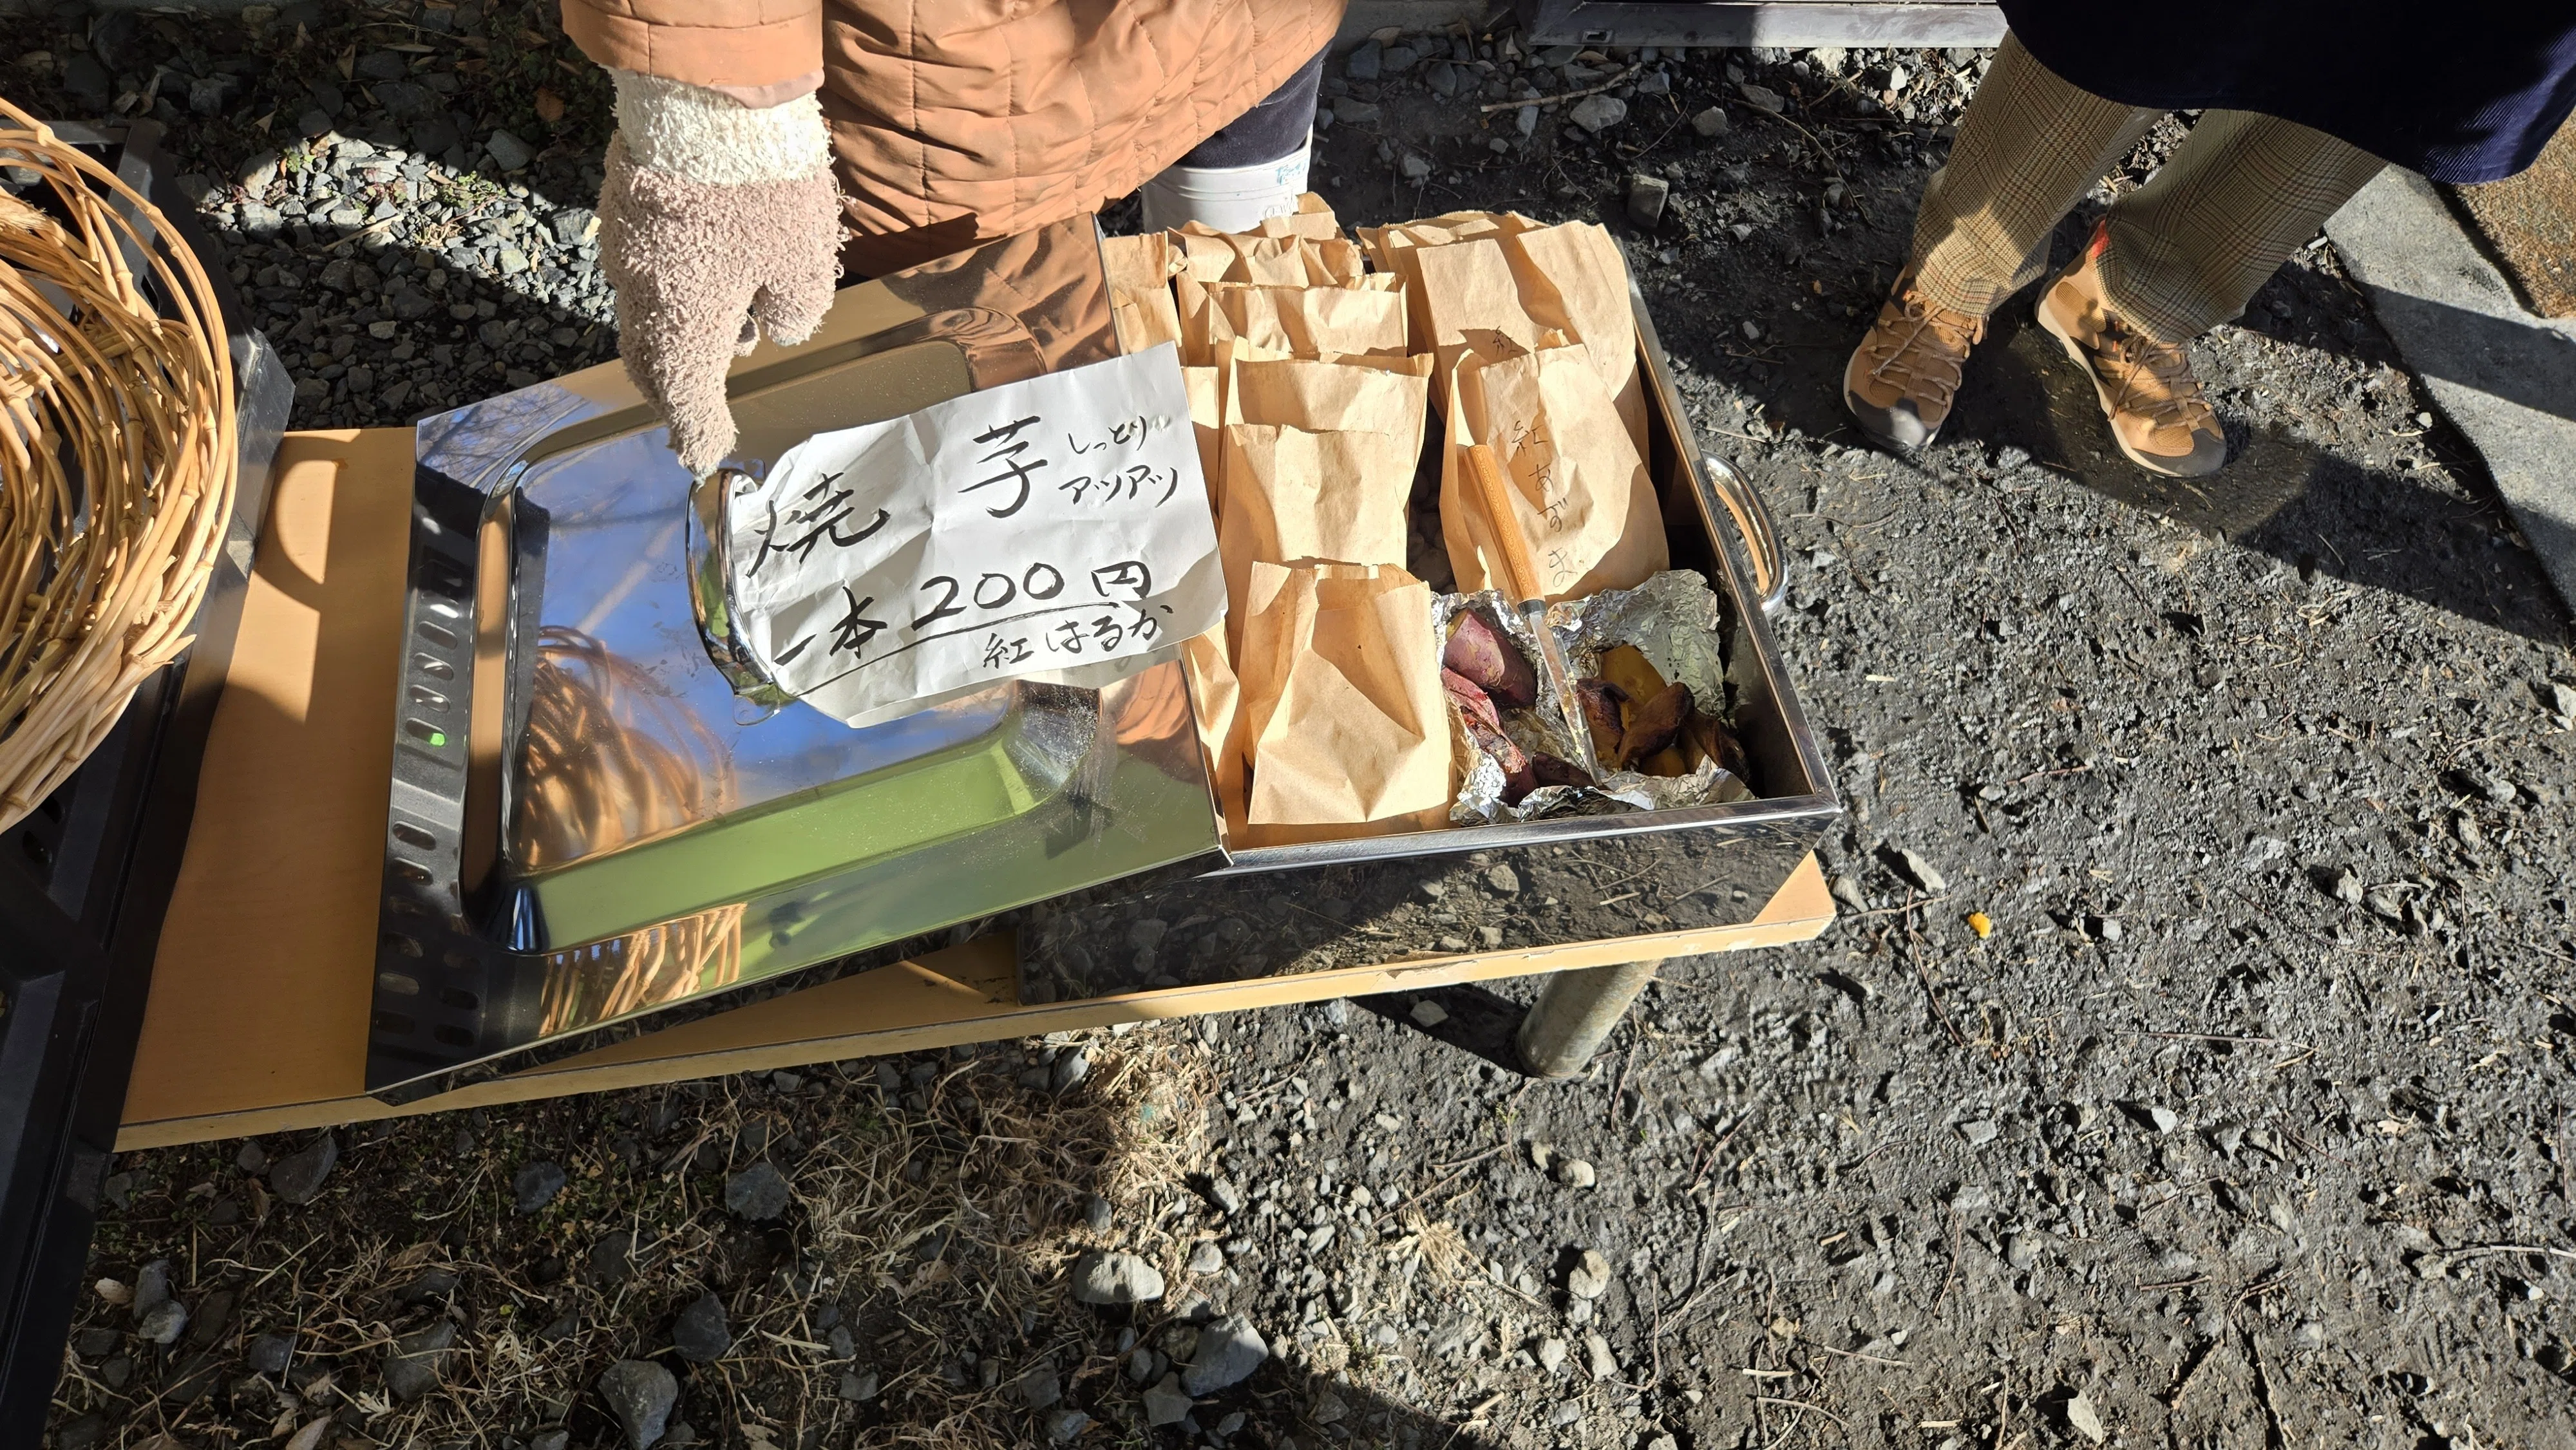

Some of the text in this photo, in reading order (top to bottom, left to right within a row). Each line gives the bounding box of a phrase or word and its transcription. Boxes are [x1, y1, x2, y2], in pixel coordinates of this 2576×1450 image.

[1068, 415, 1148, 455] しっとり
[1058, 466, 1179, 509] アツアツ
[1511, 420, 1577, 588] 紅あずま
[983, 604, 1175, 668] 紅はるか
